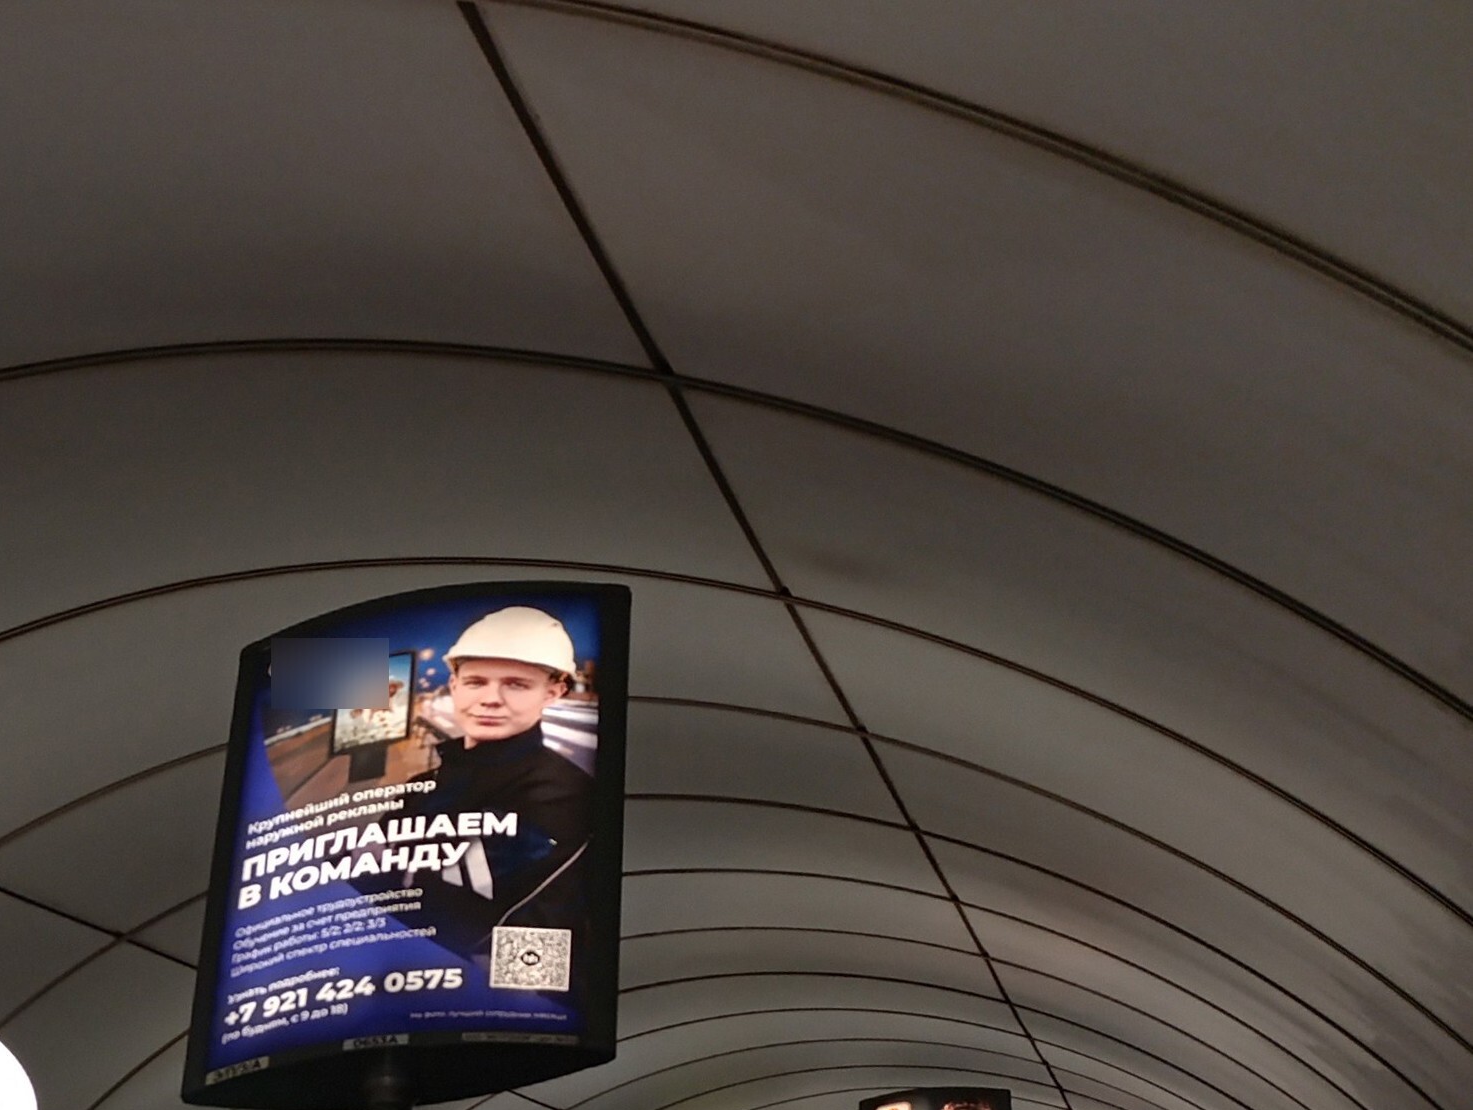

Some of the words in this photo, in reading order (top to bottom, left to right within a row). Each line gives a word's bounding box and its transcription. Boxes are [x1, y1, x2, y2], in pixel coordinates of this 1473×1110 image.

[245, 815, 324, 849] наружной
[326, 799, 404, 826] рекламы
[247, 792, 350, 835] Крупнейший
[352, 779, 437, 803] оператор
[241, 812, 518, 882] ПРИГЛАШАЕМ
[237, 884, 262, 910] В
[269, 841, 471, 900] КОМАНДУ
[232, 925, 290, 951] Обучение
[291, 920, 305, 933] за
[334, 901, 422, 924] предприятия
[234, 906, 315, 938] Официальное
[316, 888, 423, 914] трудоустройство
[329, 926, 437, 950] специальностей
[224, 1002, 257, 1026] +7
[262, 988, 309, 1017] 921
[315, 976, 375, 1002] 424
[384, 967, 463, 993] 0575
[300, 1010, 310, 1022] 9
